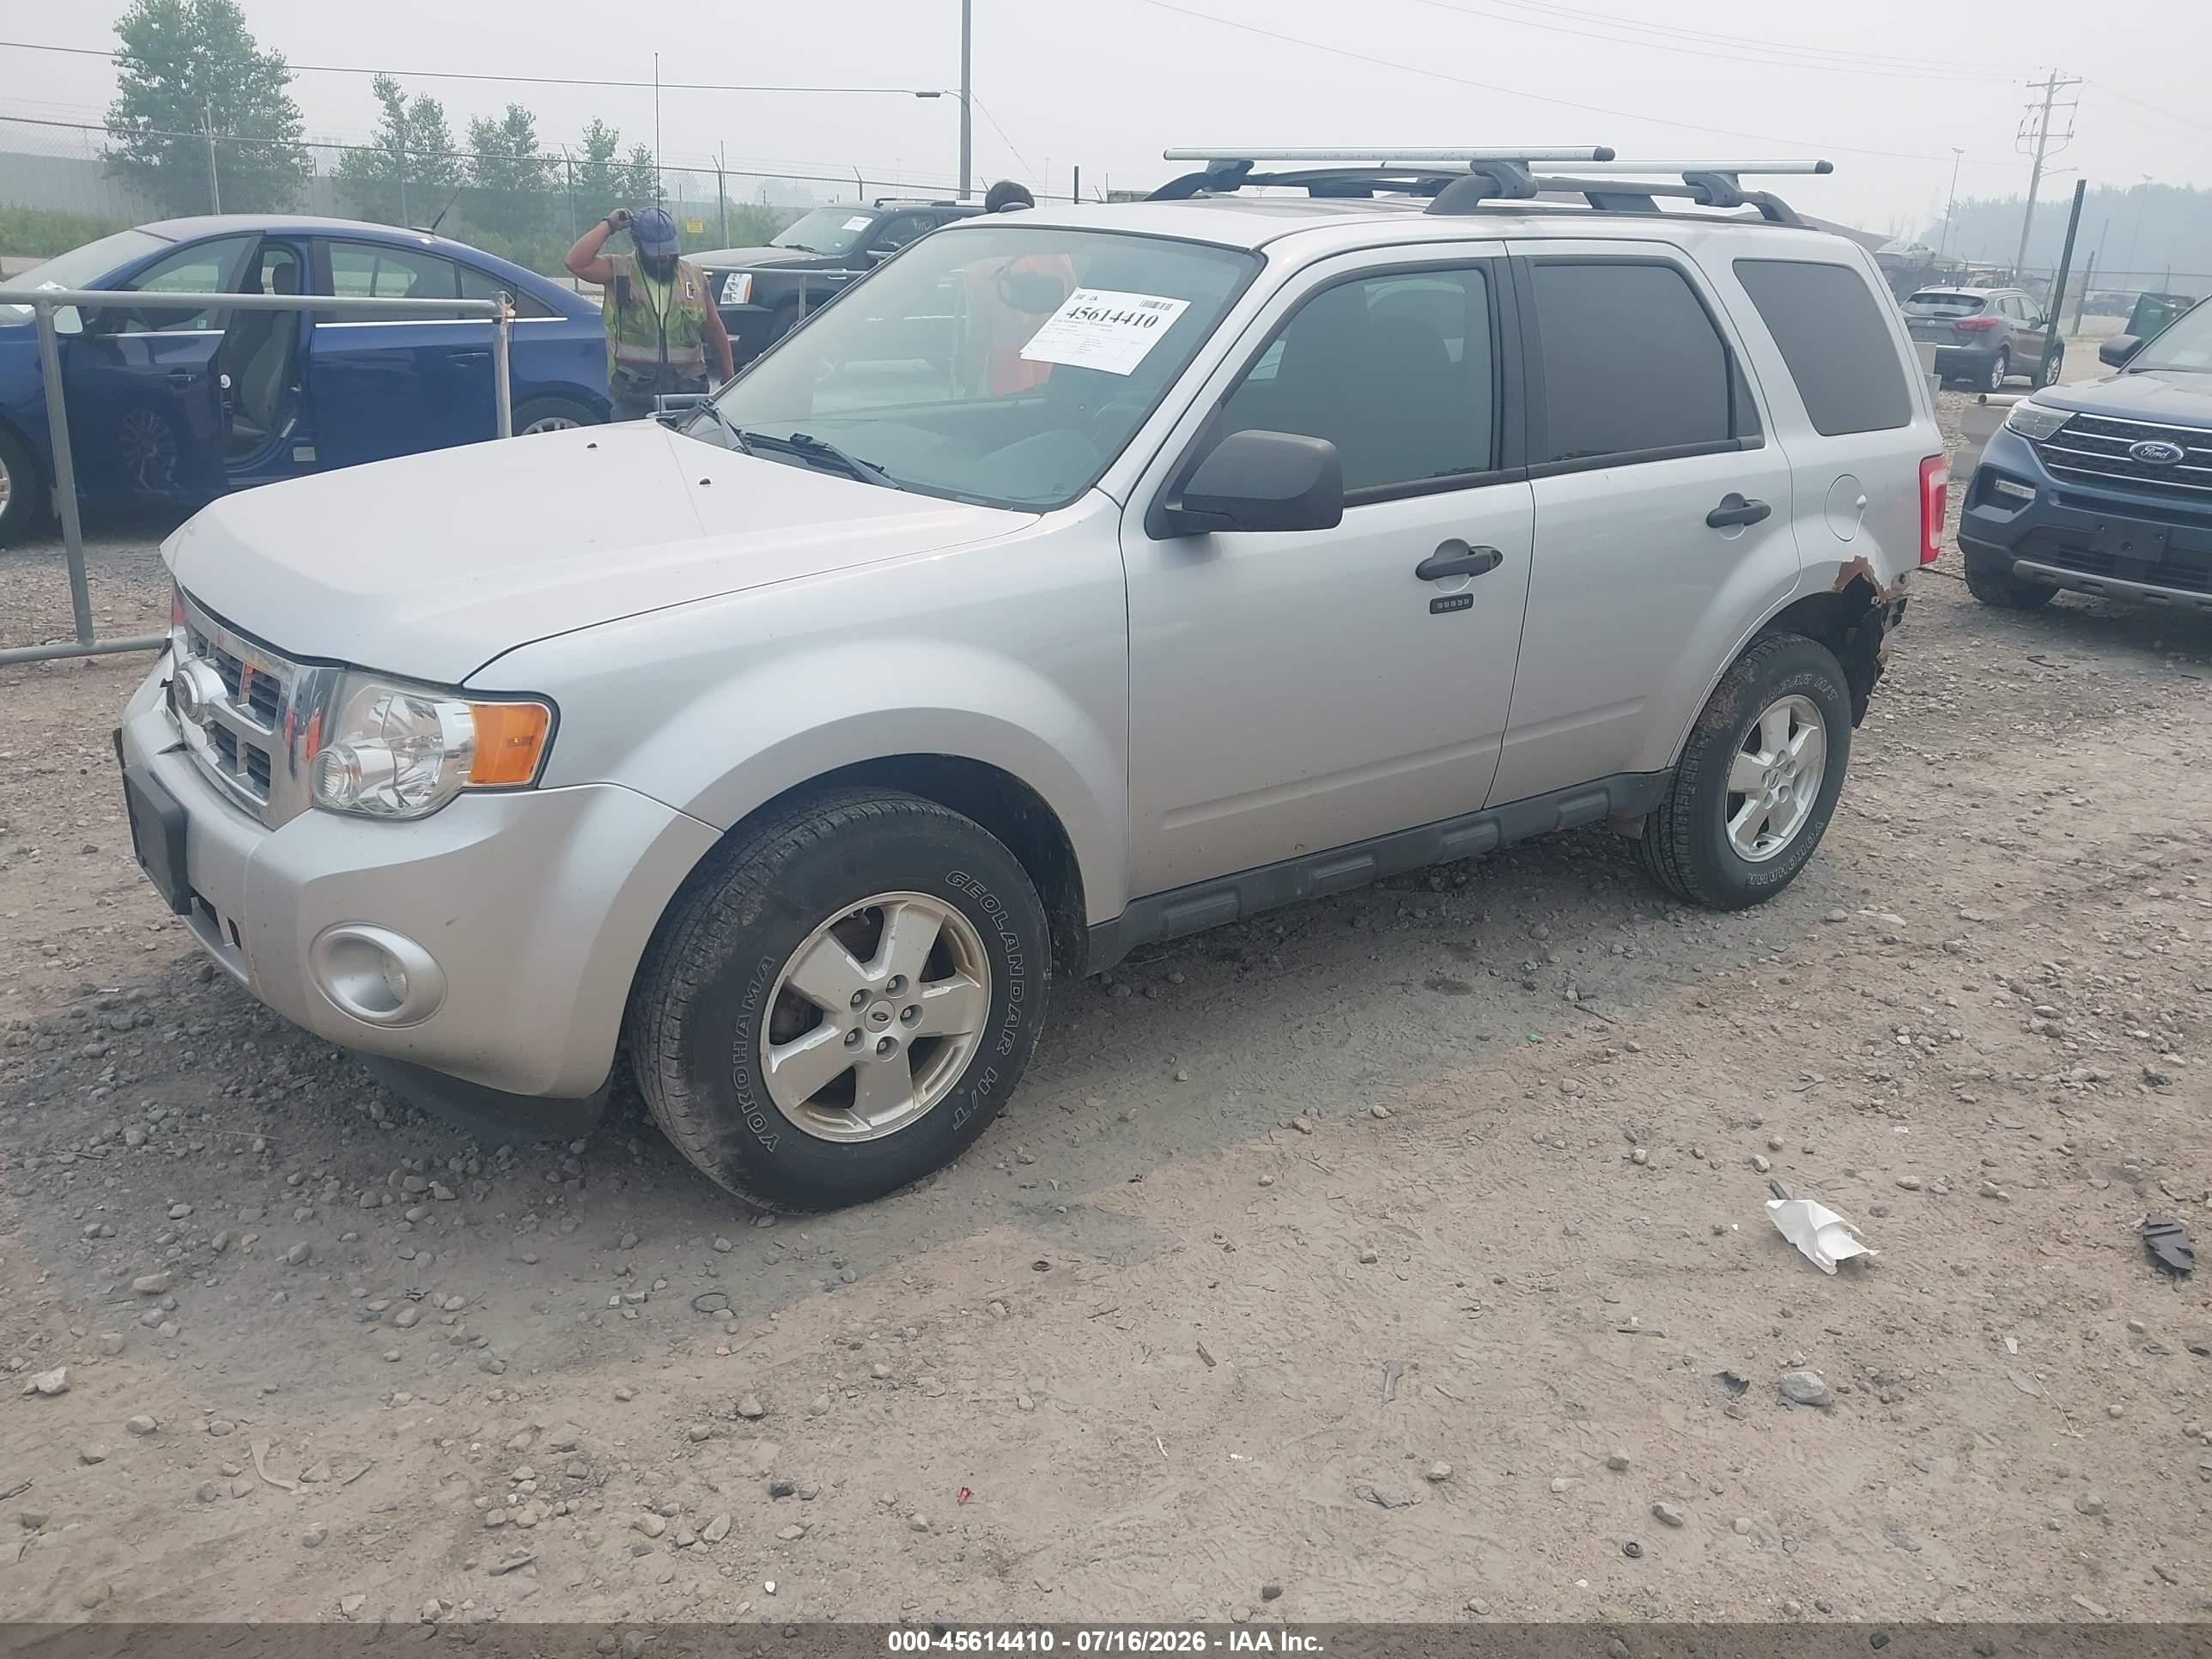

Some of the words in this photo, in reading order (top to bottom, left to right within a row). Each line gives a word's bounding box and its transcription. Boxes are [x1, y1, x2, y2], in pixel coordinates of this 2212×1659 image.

[1066, 306, 1158, 328] 45614410
[2140, 445, 2171, 459] Ford
[1747, 821, 1824, 884] YOKOHAMA
[944, 870, 1025, 1058] GEOLANDAR
[732, 956, 781, 1153] YOKOHAMA
[951, 1065, 1000, 1133] H/T
